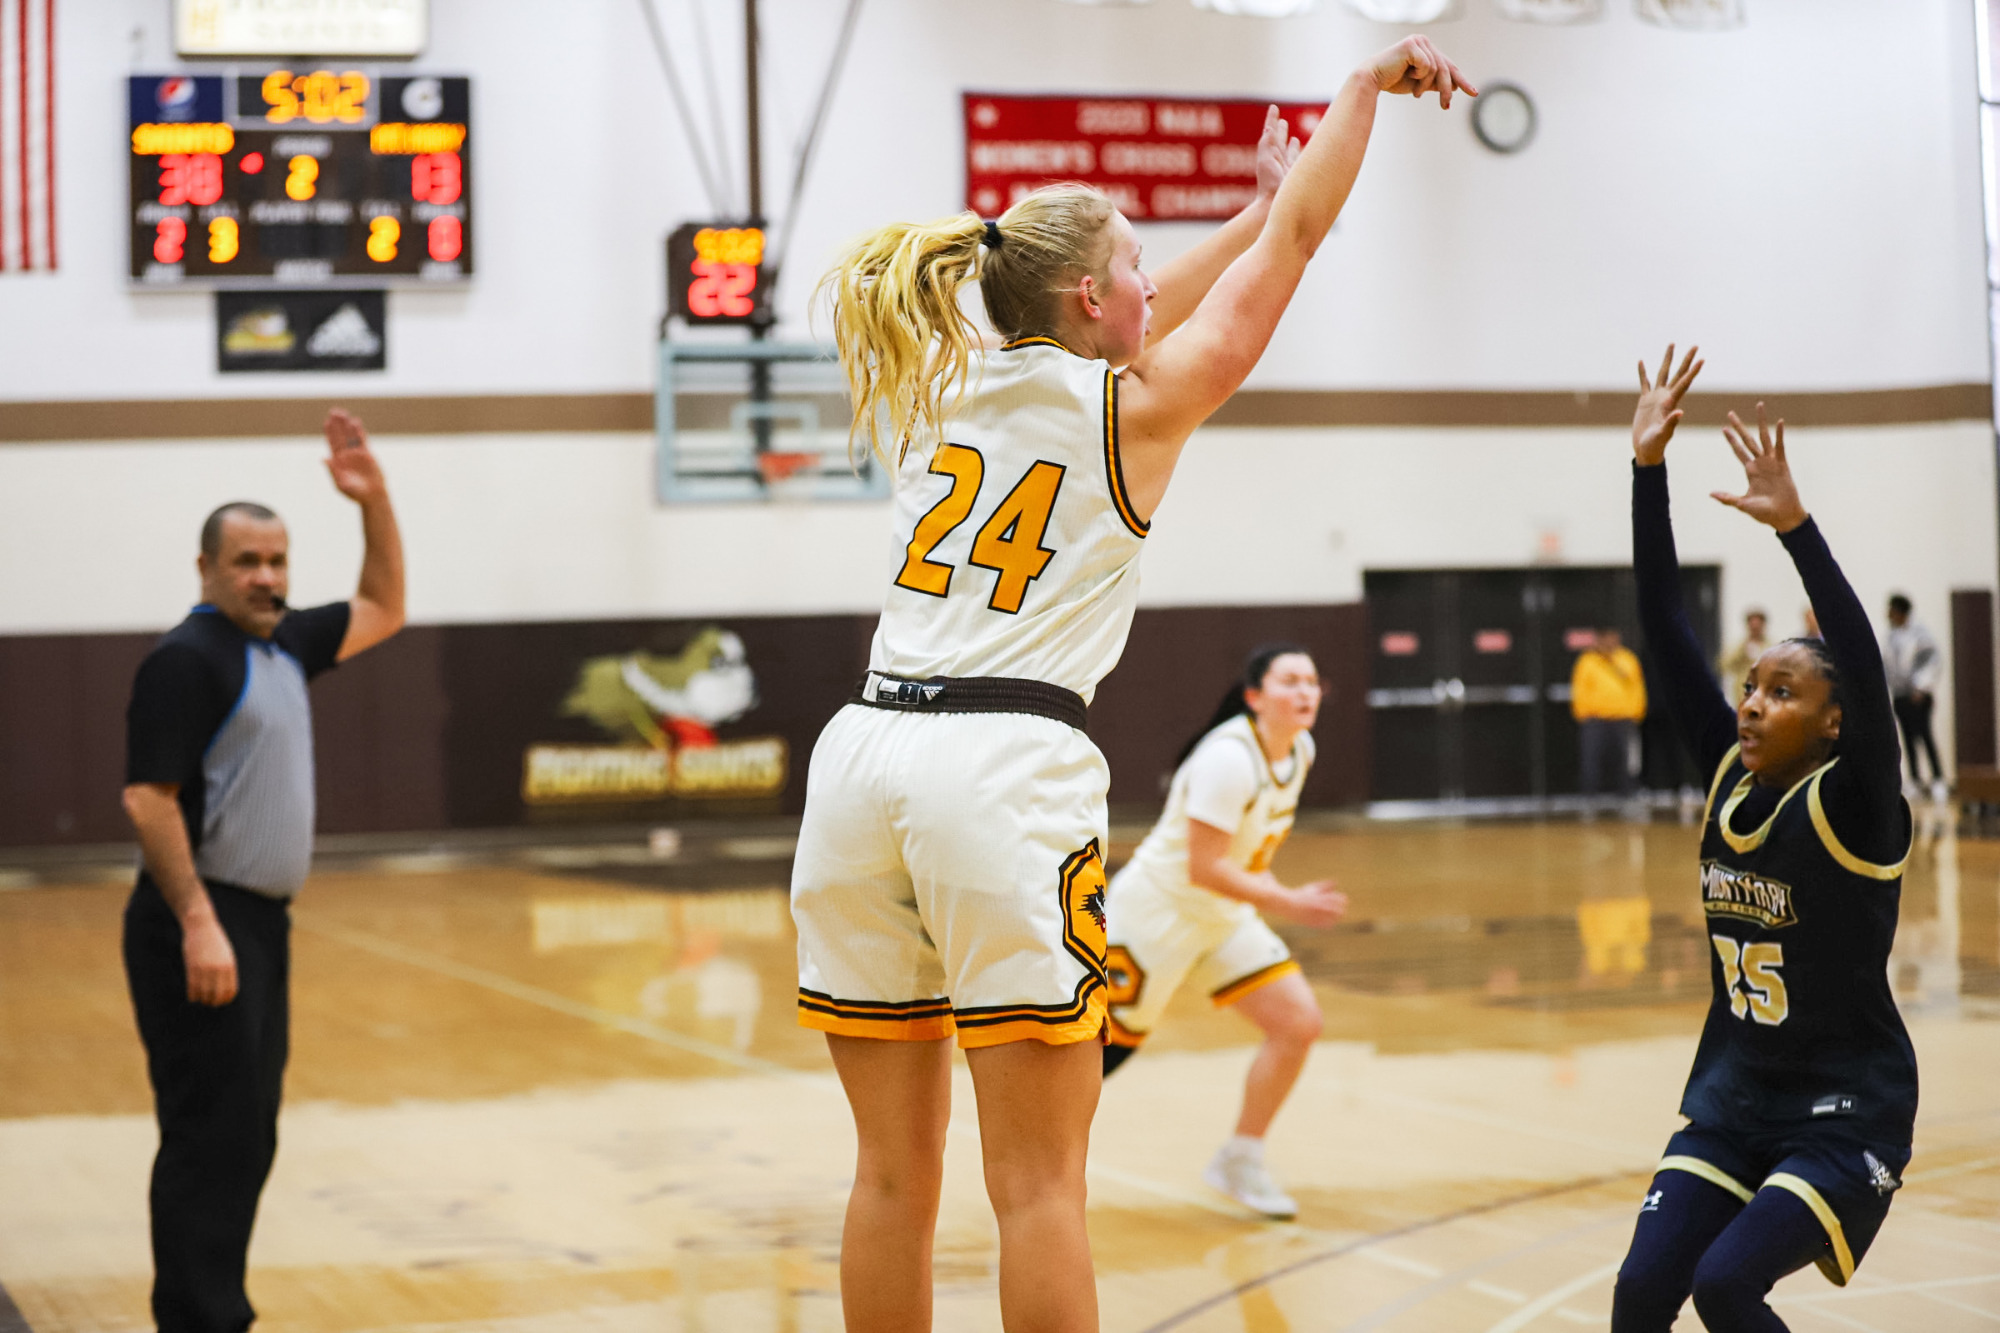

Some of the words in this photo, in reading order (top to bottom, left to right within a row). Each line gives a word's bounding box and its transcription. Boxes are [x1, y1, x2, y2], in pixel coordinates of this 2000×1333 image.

[262, 70, 370, 124] 5:02
[286, 154, 319, 201] 2
[208, 216, 239, 263] 3
[366, 215, 400, 262] 2
[894, 442, 1067, 615] 24
[1841, 1100, 1852, 1110] M
